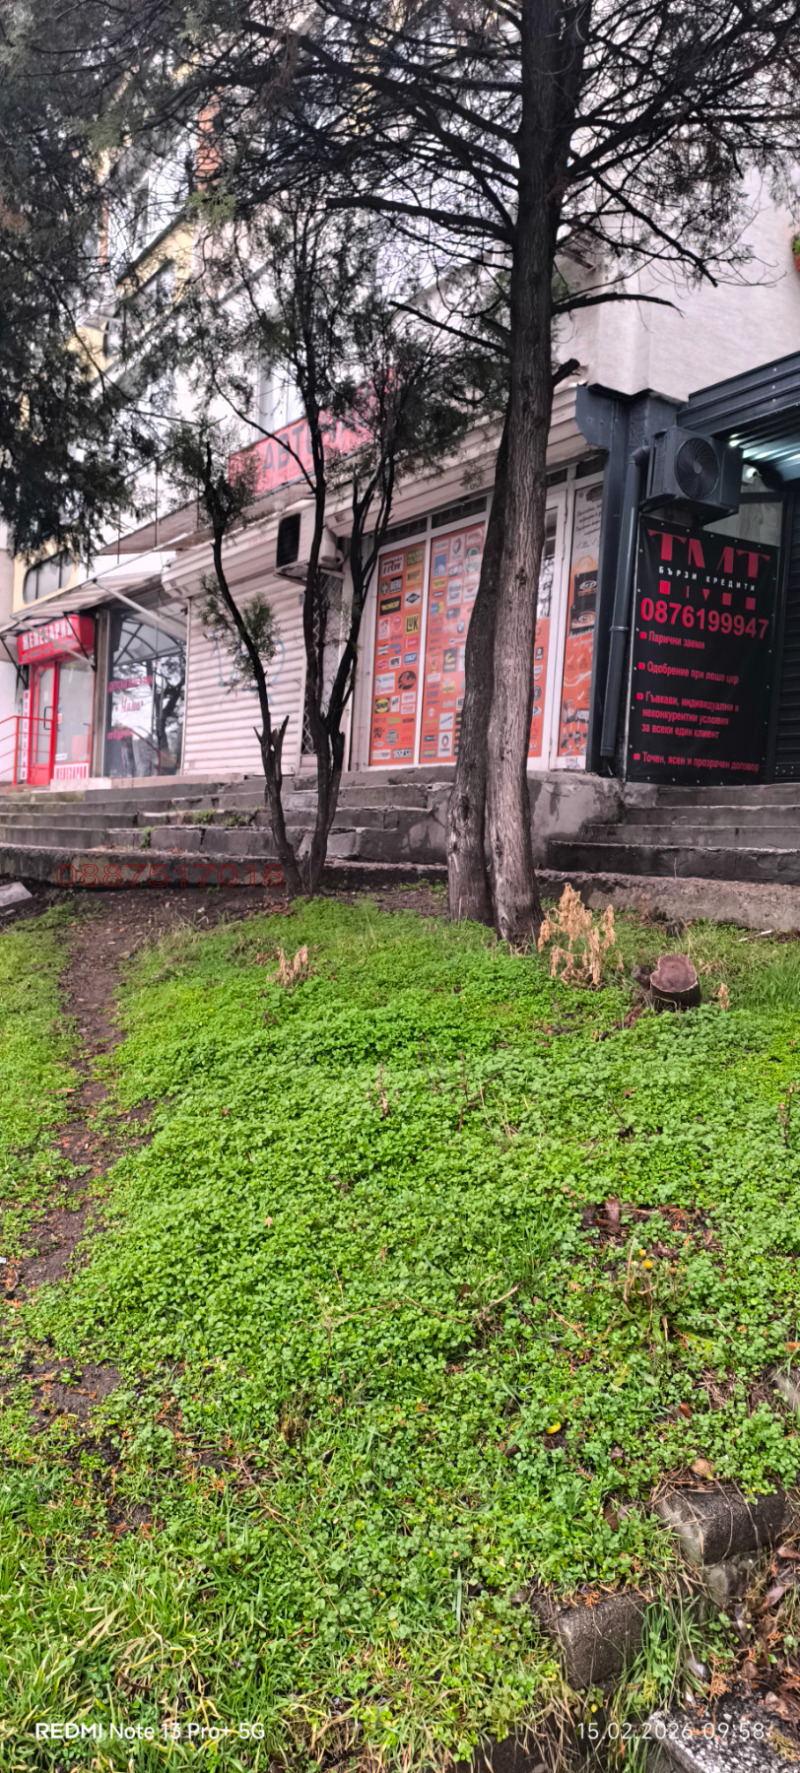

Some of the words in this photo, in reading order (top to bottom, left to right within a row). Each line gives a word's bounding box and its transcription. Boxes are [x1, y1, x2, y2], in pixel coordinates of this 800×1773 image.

[659, 566, 697, 580] БЪРЗИ
[706, 576, 755, 591] КРЕДИТИ
[641, 598, 769, 639] 0876199947
[647, 661, 689, 677] Одобрение
